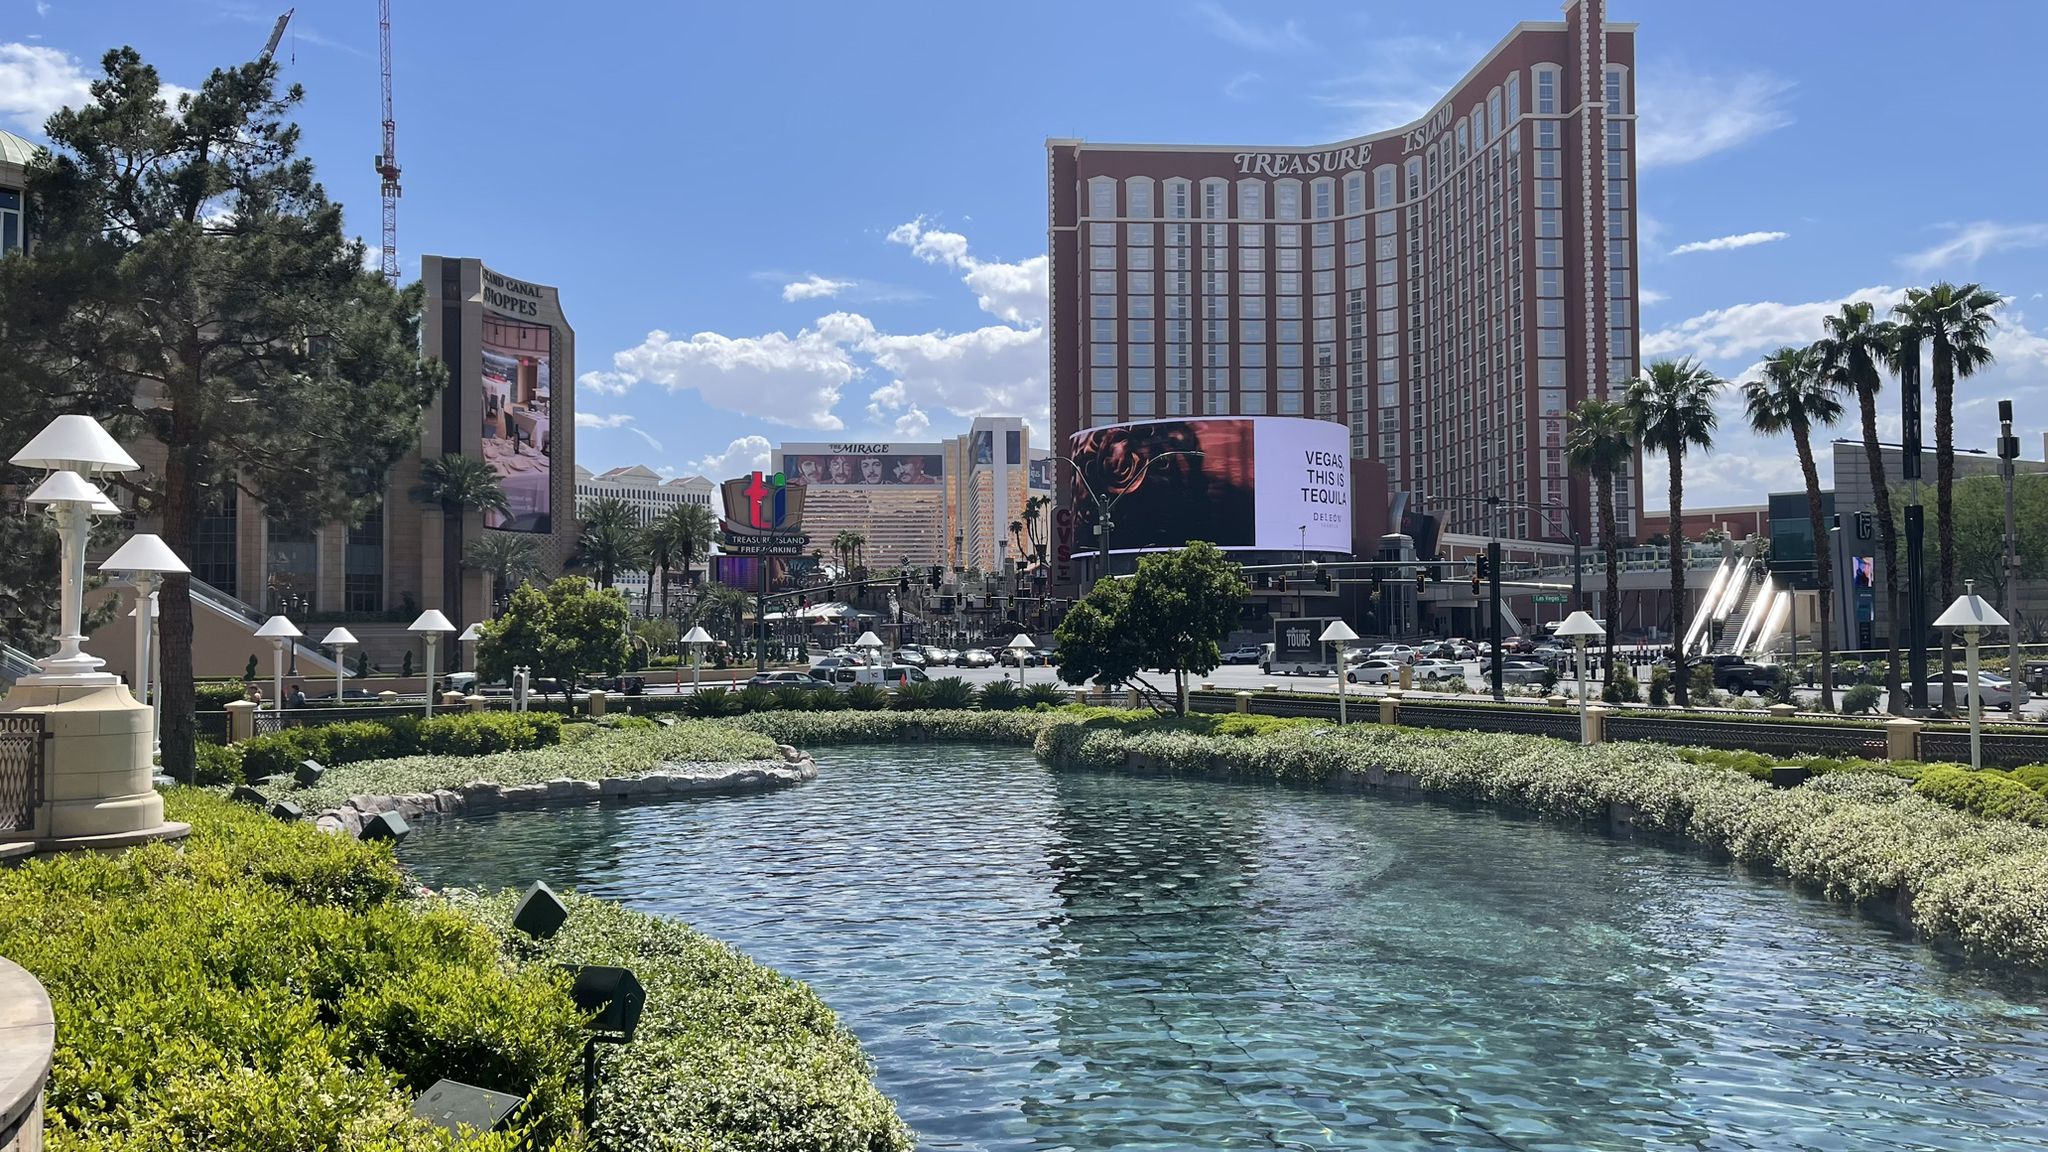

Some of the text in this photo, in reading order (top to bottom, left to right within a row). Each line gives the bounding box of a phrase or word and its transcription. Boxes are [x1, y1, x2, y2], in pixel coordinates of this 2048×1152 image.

[1234, 102, 1454, 178] TREASURE ISLAND
[506, 280, 543, 299] CANAL
[483, 286, 537, 316] SHOPPES
[833, 444, 889, 455] MIRAGE
[1305, 450, 1345, 471] VEGAS,
[1307, 469, 1345, 487] THIS IS
[1301, 487, 1347, 506] TEQUILA
[1056, 508, 1071, 562] CVS
[1545, 595, 1560, 603] Vegas
[1286, 633, 1311, 647] TOURS
